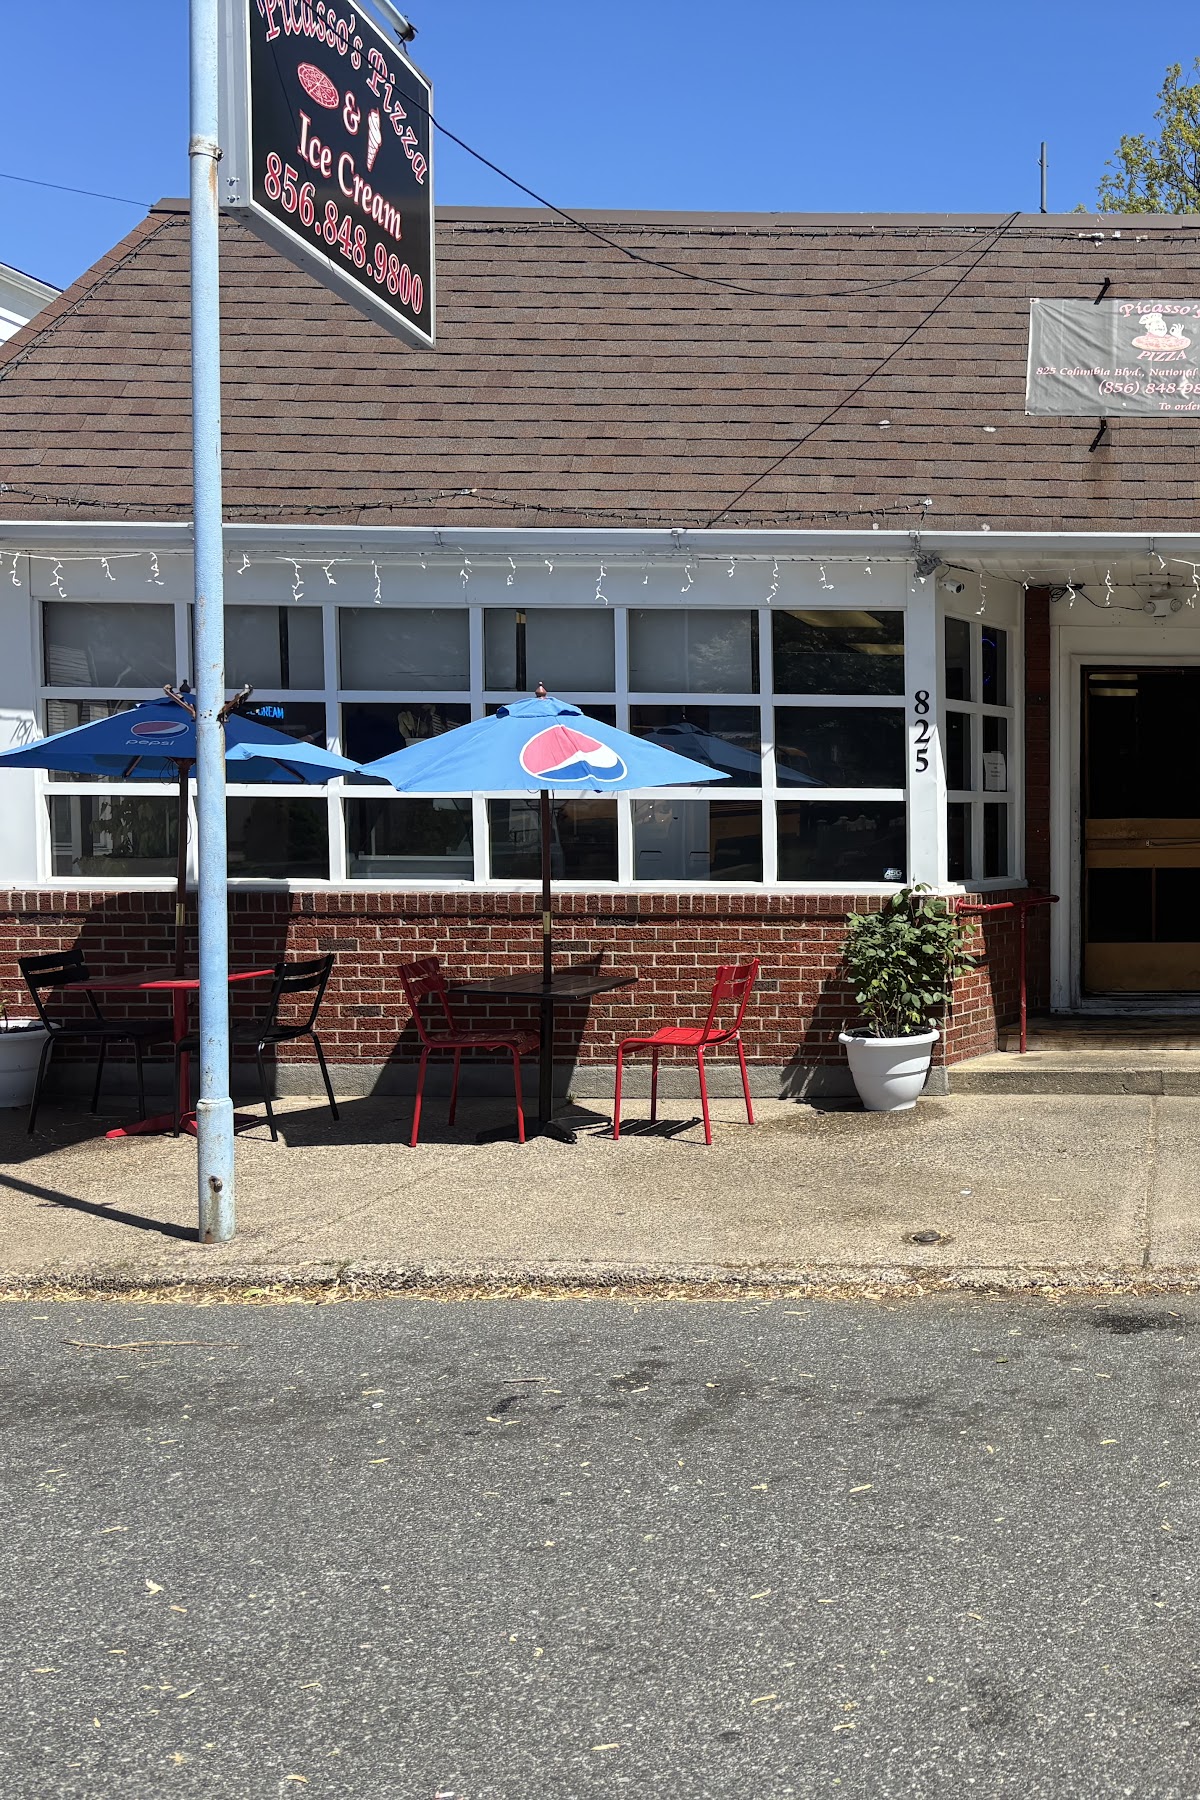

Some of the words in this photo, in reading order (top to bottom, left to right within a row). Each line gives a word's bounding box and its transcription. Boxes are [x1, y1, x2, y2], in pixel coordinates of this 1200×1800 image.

[342, 90, 361, 136] &
[366, 47, 428, 185] Pizza
[297, 108, 333, 178] Ice
[338, 151, 403, 241] Cream
[264, 151, 424, 315] 856.848.9800
[1035, 366, 1056, 375] 825
[1149, 367, 1196, 376] National
[1136, 350, 1187, 362] PIZZA
[1098, 379, 1140, 396] (856)
[1158, 402, 1171, 411] To
[913, 689, 931, 773] 825
